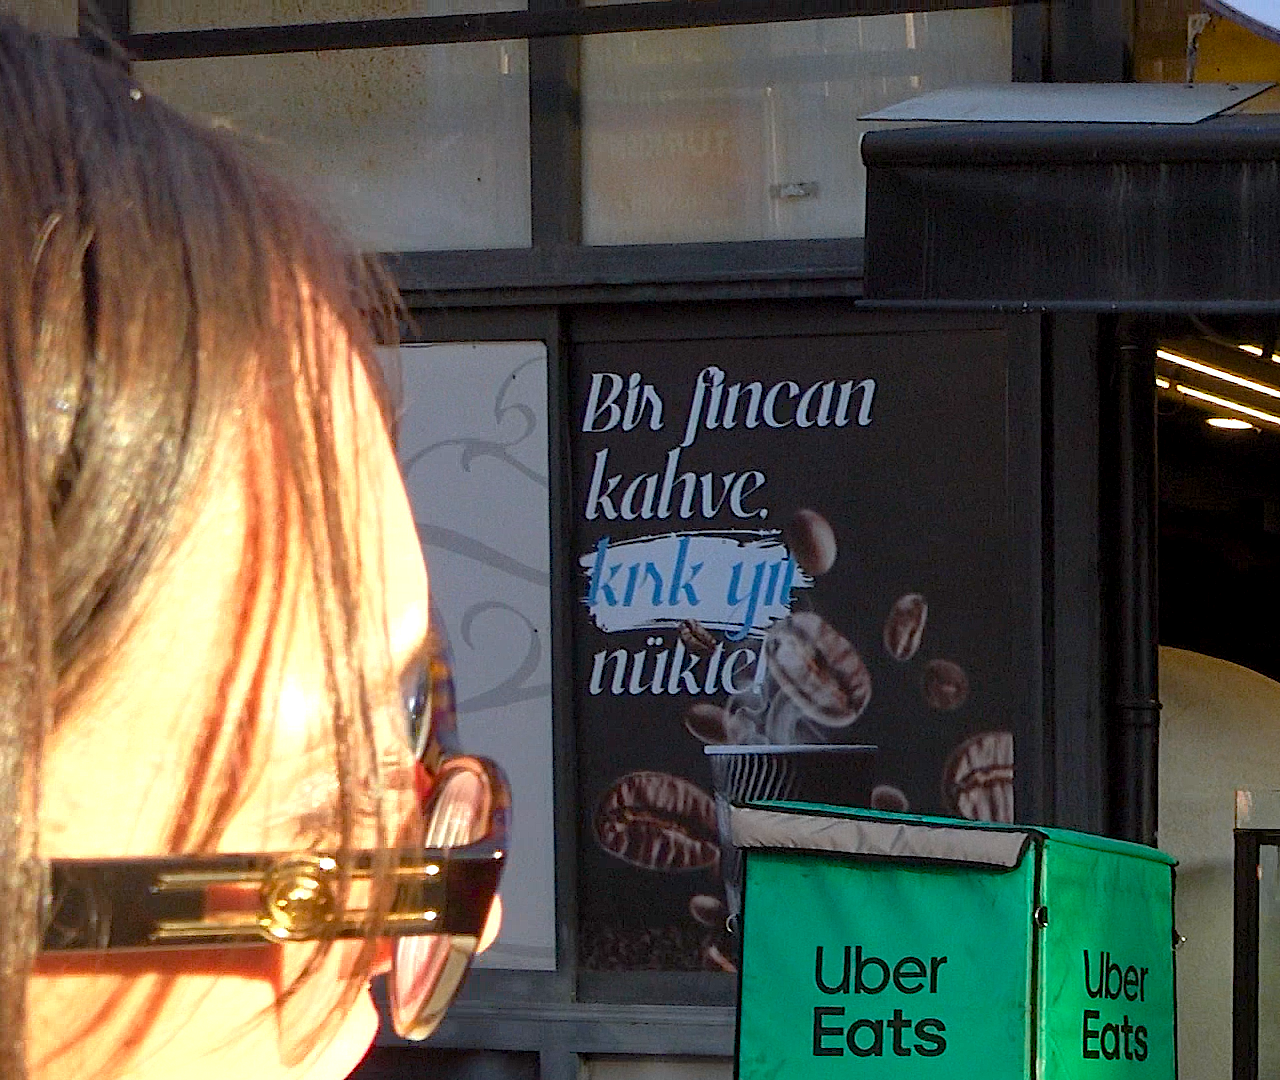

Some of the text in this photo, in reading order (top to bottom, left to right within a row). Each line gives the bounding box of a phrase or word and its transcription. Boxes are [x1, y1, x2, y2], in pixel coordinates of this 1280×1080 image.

[582, 366, 877, 447] Bir fincan
[814, 946, 948, 996] Uber
[1082, 950, 1149, 1002] Uber
[812, 1007, 948, 1057] Eats
[1082, 1010, 1149, 1062] Eats
